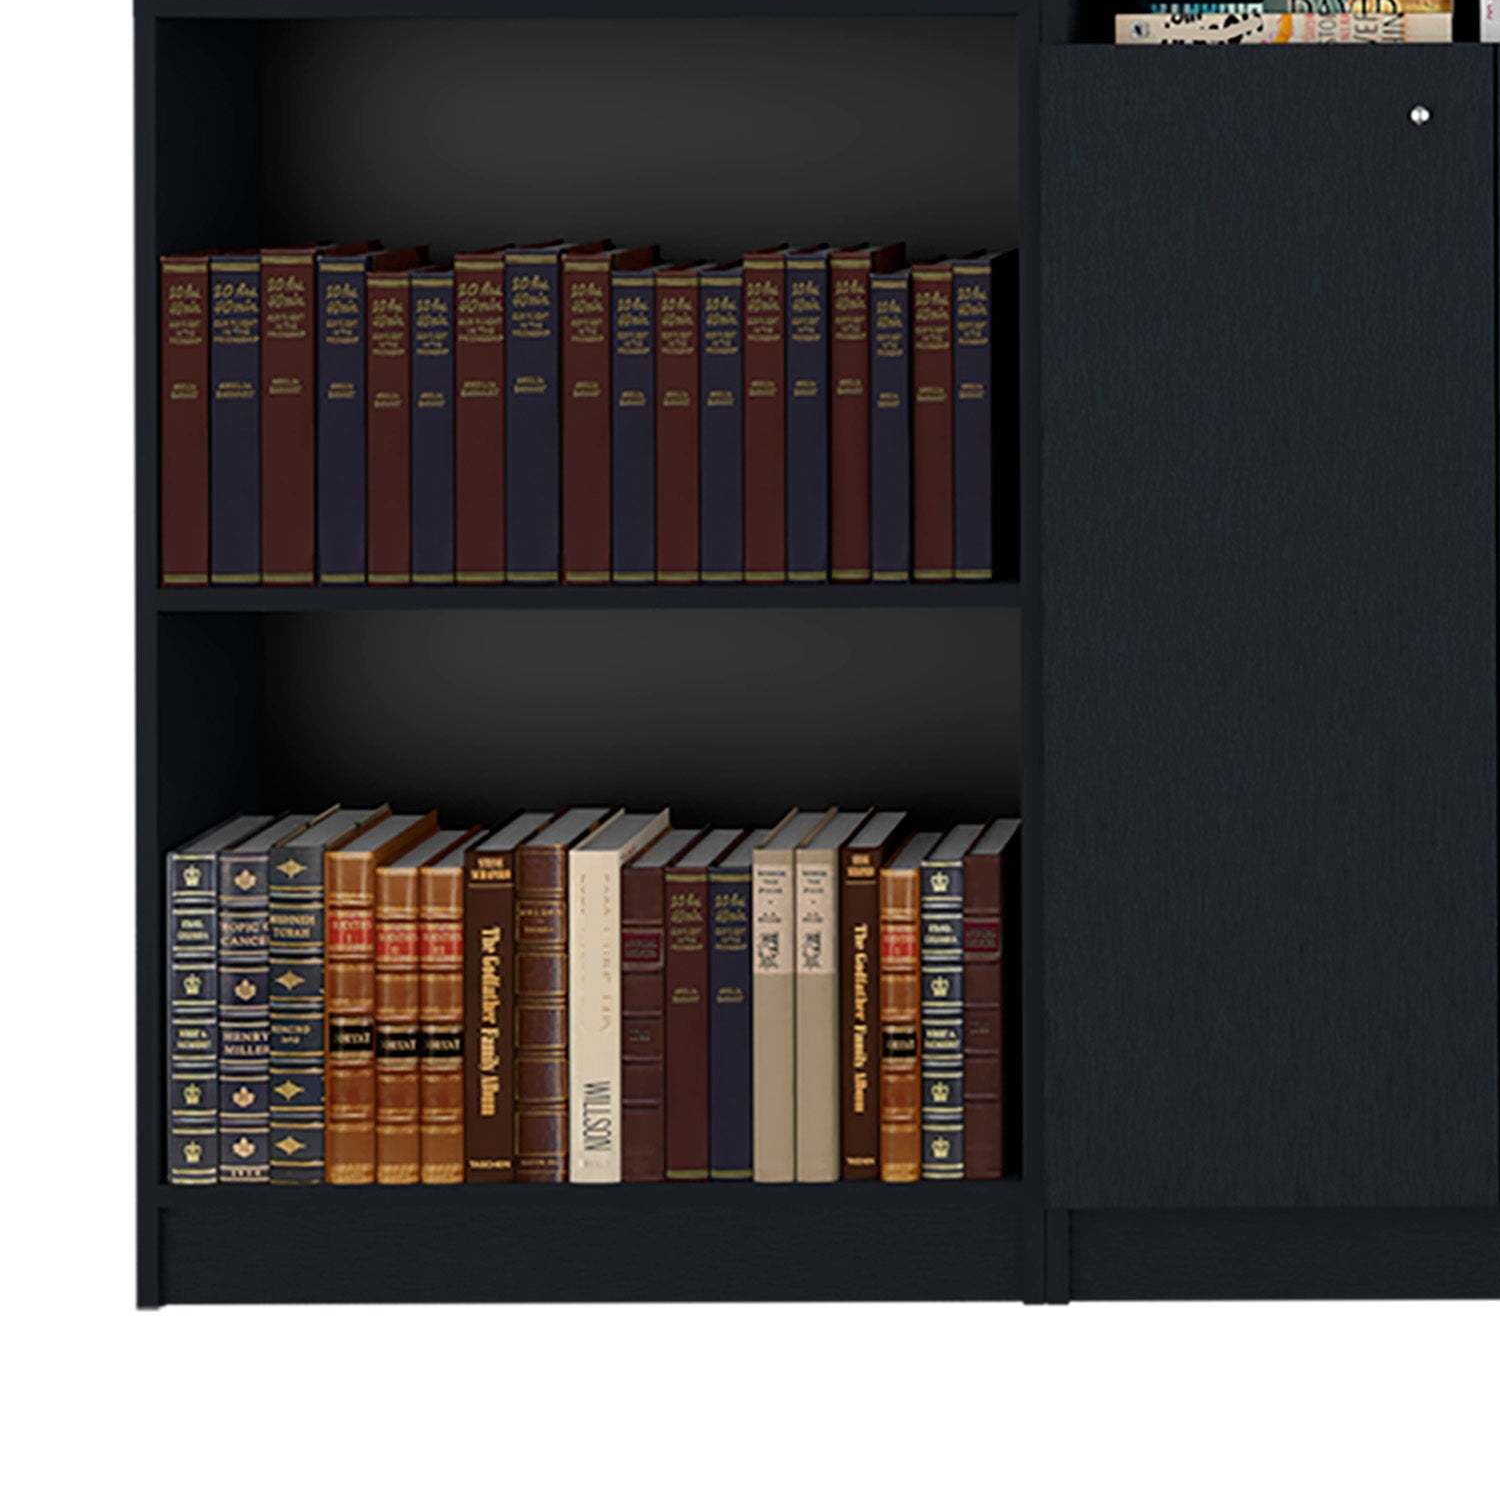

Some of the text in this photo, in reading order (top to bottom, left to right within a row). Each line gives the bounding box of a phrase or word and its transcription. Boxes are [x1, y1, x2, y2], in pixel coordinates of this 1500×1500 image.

[219, 936, 270, 947] CANCE
[481, 956, 500, 1024] Godfather
[480, 1027, 500, 1071] Family
[582, 1080, 613, 1152] WILLSON
